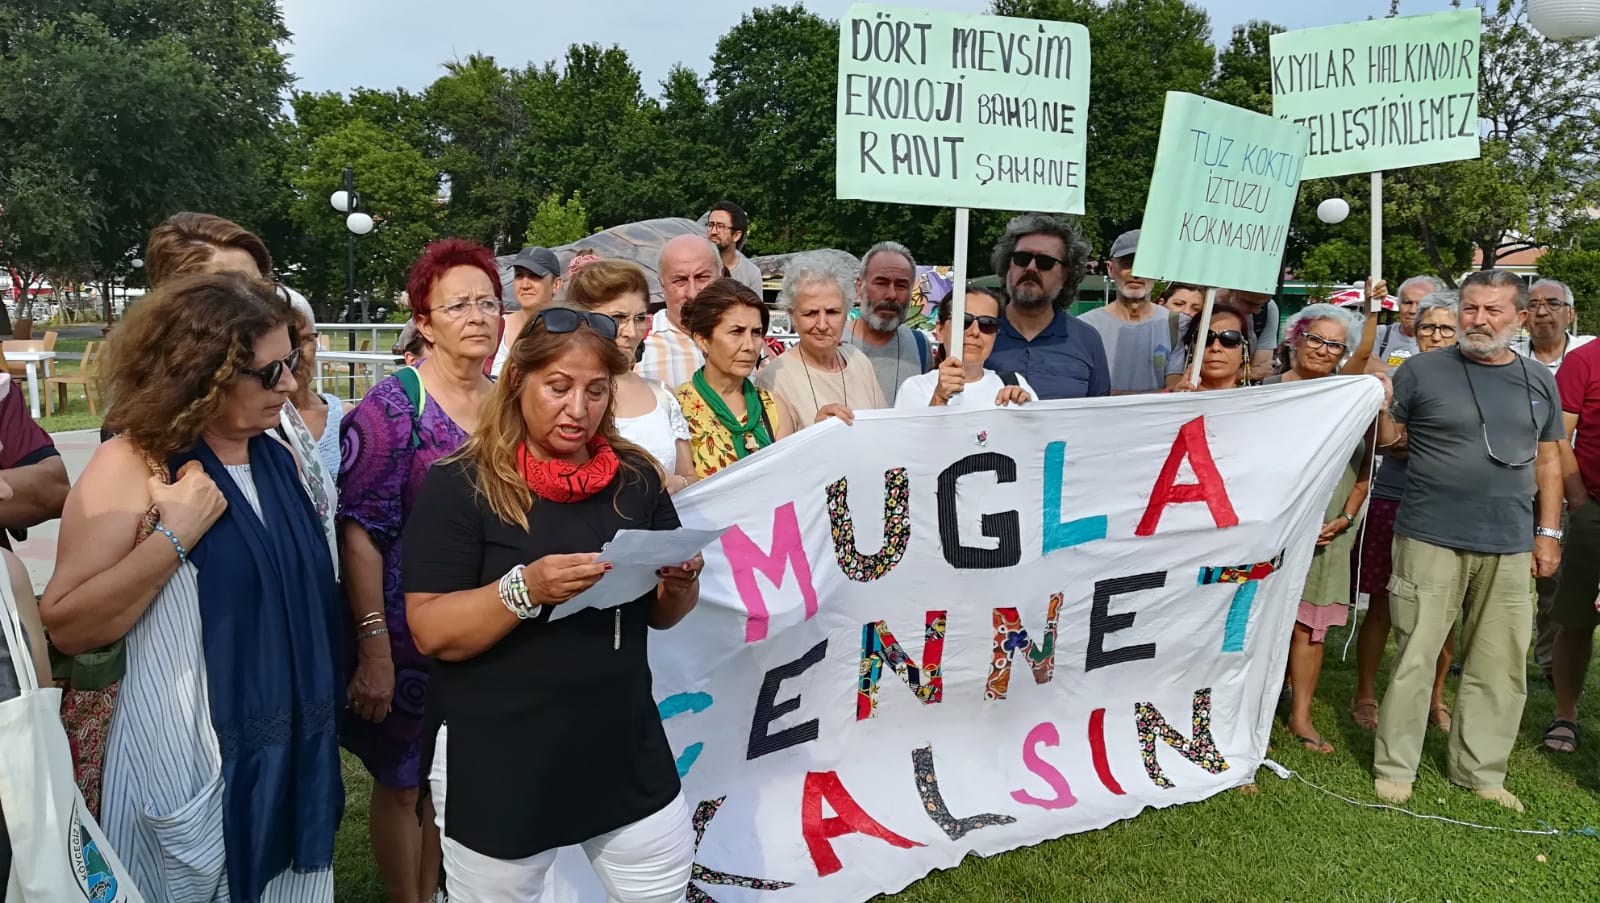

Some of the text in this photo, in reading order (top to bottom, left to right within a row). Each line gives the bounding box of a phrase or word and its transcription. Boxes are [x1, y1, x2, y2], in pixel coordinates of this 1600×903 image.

[851, 12, 1071, 80] DÖRT MEVSİM
[1272, 39, 1475, 95] KIYILAR HALKINDIR
[845, 74, 1076, 134] EKOLOJİ BAHANE
[1280, 93, 1475, 155] ELLEŞTİRİLEMEZ
[860, 131, 1079, 188] RANT ŞAHANE
[1190, 129, 1301, 188] TUZ KOKTU
[1206, 169, 1271, 214] İZTUZU
[1179, 212, 1284, 257] KOKMASIN!!
